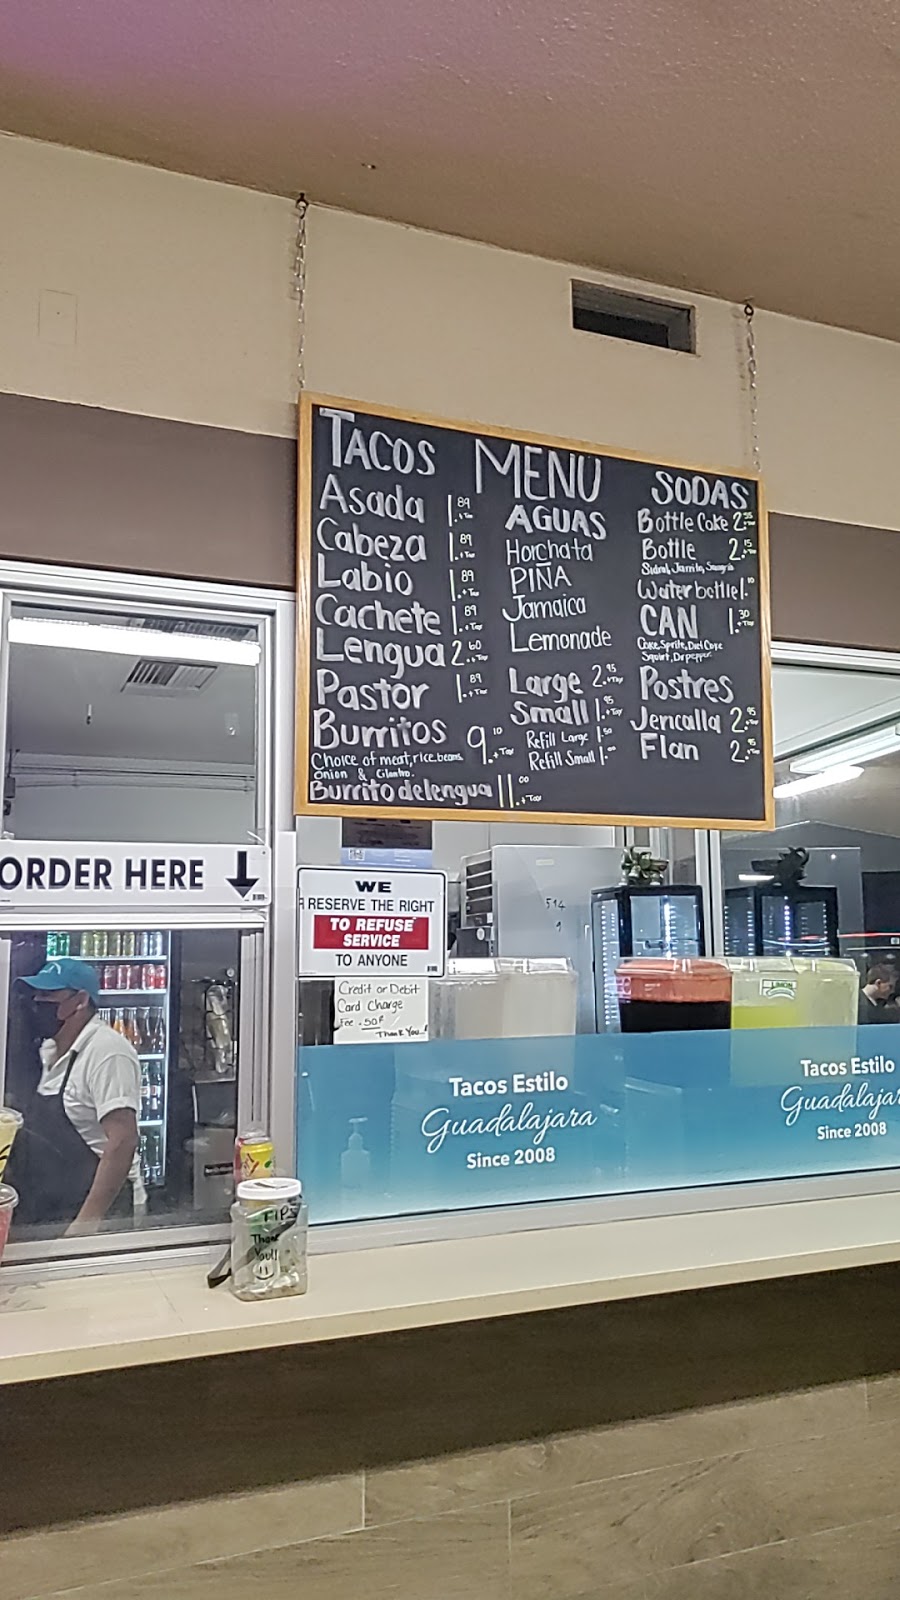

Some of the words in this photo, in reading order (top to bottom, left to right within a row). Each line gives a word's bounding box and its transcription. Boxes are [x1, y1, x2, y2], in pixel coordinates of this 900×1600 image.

[319, 407, 435, 475] TACOS
[475, 438, 602, 502] MENU
[319, 473, 425, 523] Asada
[651, 470, 749, 509] SODAS
[504, 504, 607, 540] AGUAS
[637, 507, 694, 533] Bottle
[696, 512, 729, 532] Coke
[316, 517, 427, 562] Cabeza
[505, 538, 594, 566] Horchata
[642, 538, 697, 560] Bottle
[317, 552, 414, 596] Labio
[509, 562, 573, 594] PIÑA
[637, 578, 693, 600] Water
[694, 580, 738, 600] bottle
[315, 593, 442, 636] Cachete
[502, 593, 587, 622] Jamaica
[639, 603, 698, 639] CAN
[509, 621, 613, 653] Lemonade
[316, 626, 446, 680] Lengua
[316, 668, 430, 710] Pastor
[508, 667, 584, 703] Large
[639, 664, 734, 704] Postres
[510, 699, 590, 726] Small
[313, 708, 448, 750] Burritos
[526, 730, 556, 749] Refill
[561, 731, 589, 746] Large
[311, 752, 359, 770] Choice
[362, 751, 377, 767] of
[528, 750, 563, 771] Refill
[564, 749, 596, 767] Small
[639, 732, 699, 761] Flan
[357, 767, 367, 781] &
[310, 778, 395, 803] Burrito
[0, 857, 112, 890] ORDER
[125, 858, 204, 890] HERE
[355, 880, 391, 893] WE
[308, 897, 365, 910] RESERVE
[371, 899, 394, 911] THE
[399, 900, 435, 912] RIGHT
[330, 918, 351, 931] TO
[355, 918, 414, 932] REFUSE
[343, 934, 401, 947] SERVICE
[335, 954, 352, 967] TO
[357, 954, 408, 967] ANYONE
[338, 981, 372, 995] Credit
[376, 985, 388, 994] or
[389, 983, 420, 995] Debit
[337, 998, 361, 1013] Card
[367, 999, 403, 1014] Charge
[800, 1059, 848, 1077] Tacos
[850, 1055, 895, 1074] Estilo
[449, 1076, 508, 1097] Tacos
[512, 1070, 569, 1094] Estilo
[421, 1101, 598, 1154] Guadalajara
[817, 1125, 852, 1140] Since
[854, 1121, 887, 1138] 2008
[466, 1152, 510, 1169] Since
[514, 1147, 555, 1165] 2008
